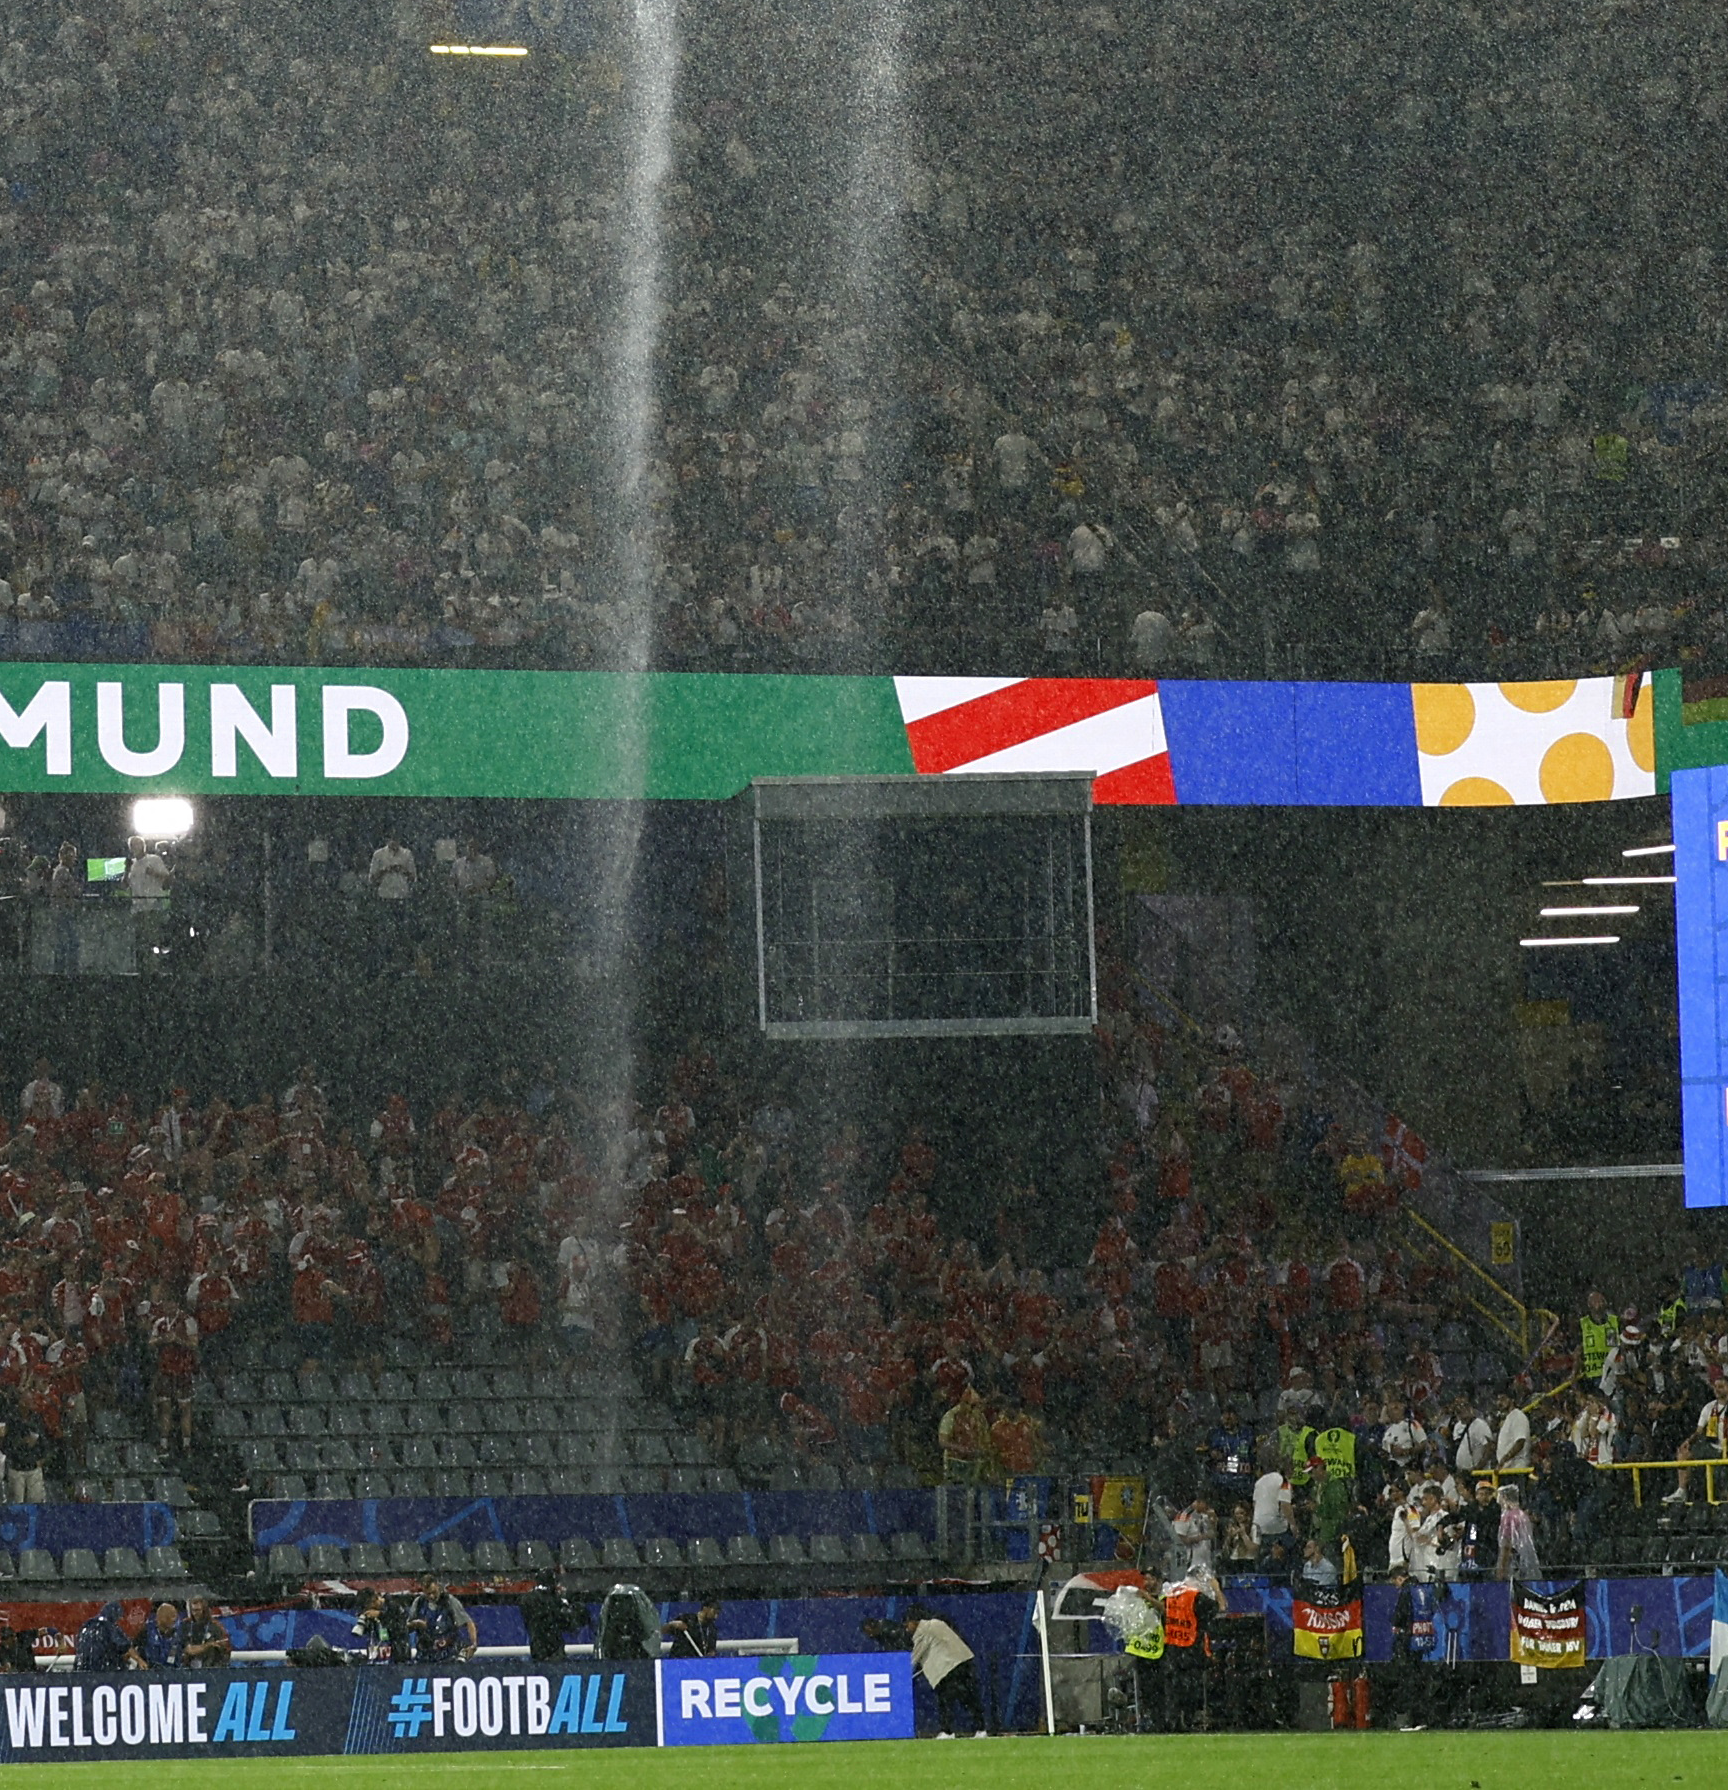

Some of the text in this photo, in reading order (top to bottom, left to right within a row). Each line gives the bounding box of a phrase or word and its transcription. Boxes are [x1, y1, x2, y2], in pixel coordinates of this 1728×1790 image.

[4, 1681, 296, 1748] WELCOME ALL
[387, 1673, 628, 1738] #FOOTBALL
[681, 1673, 891, 1719] RECYCLE
